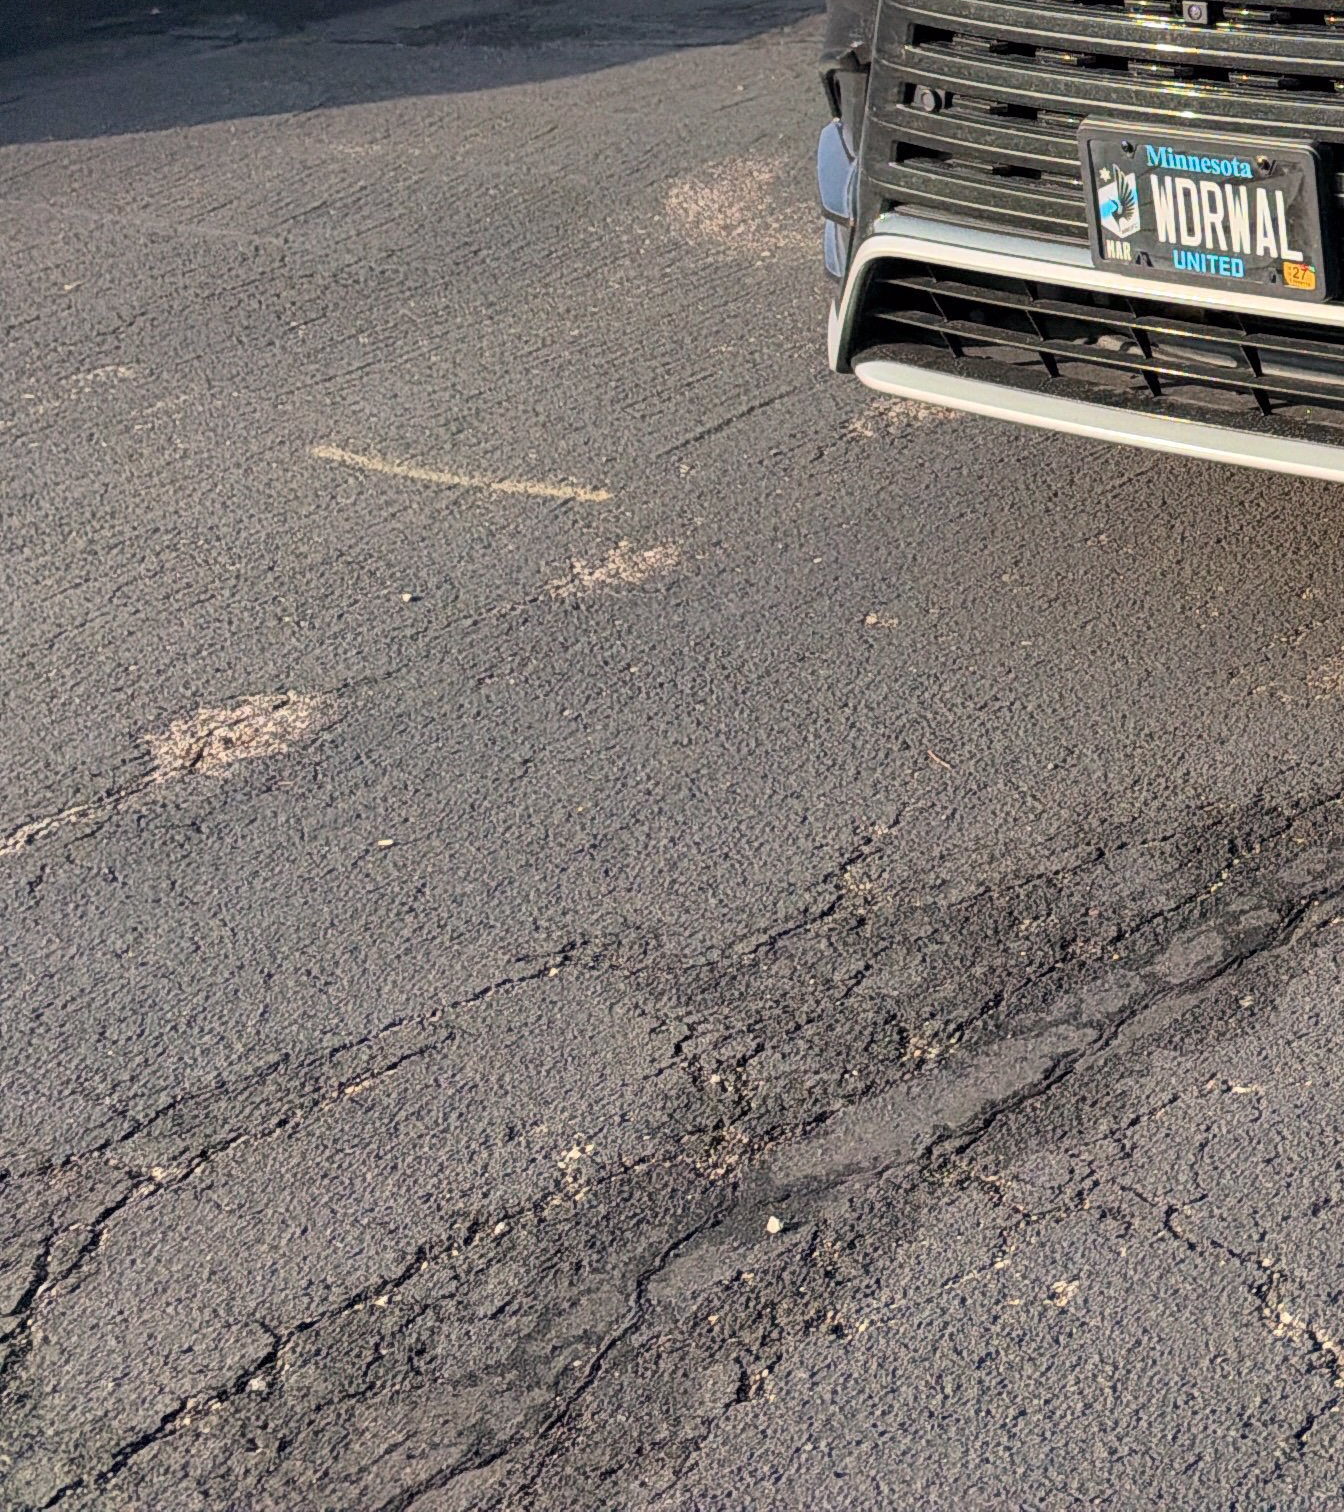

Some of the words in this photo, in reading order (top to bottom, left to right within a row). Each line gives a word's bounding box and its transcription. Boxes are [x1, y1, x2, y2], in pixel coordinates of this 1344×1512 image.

[1145, 144, 1254, 179] Minnesota
[1150, 173, 1304, 262] WDRWAL
[1172, 249, 1245, 279] UNITED
[1292, 266, 1307, 280] 27
